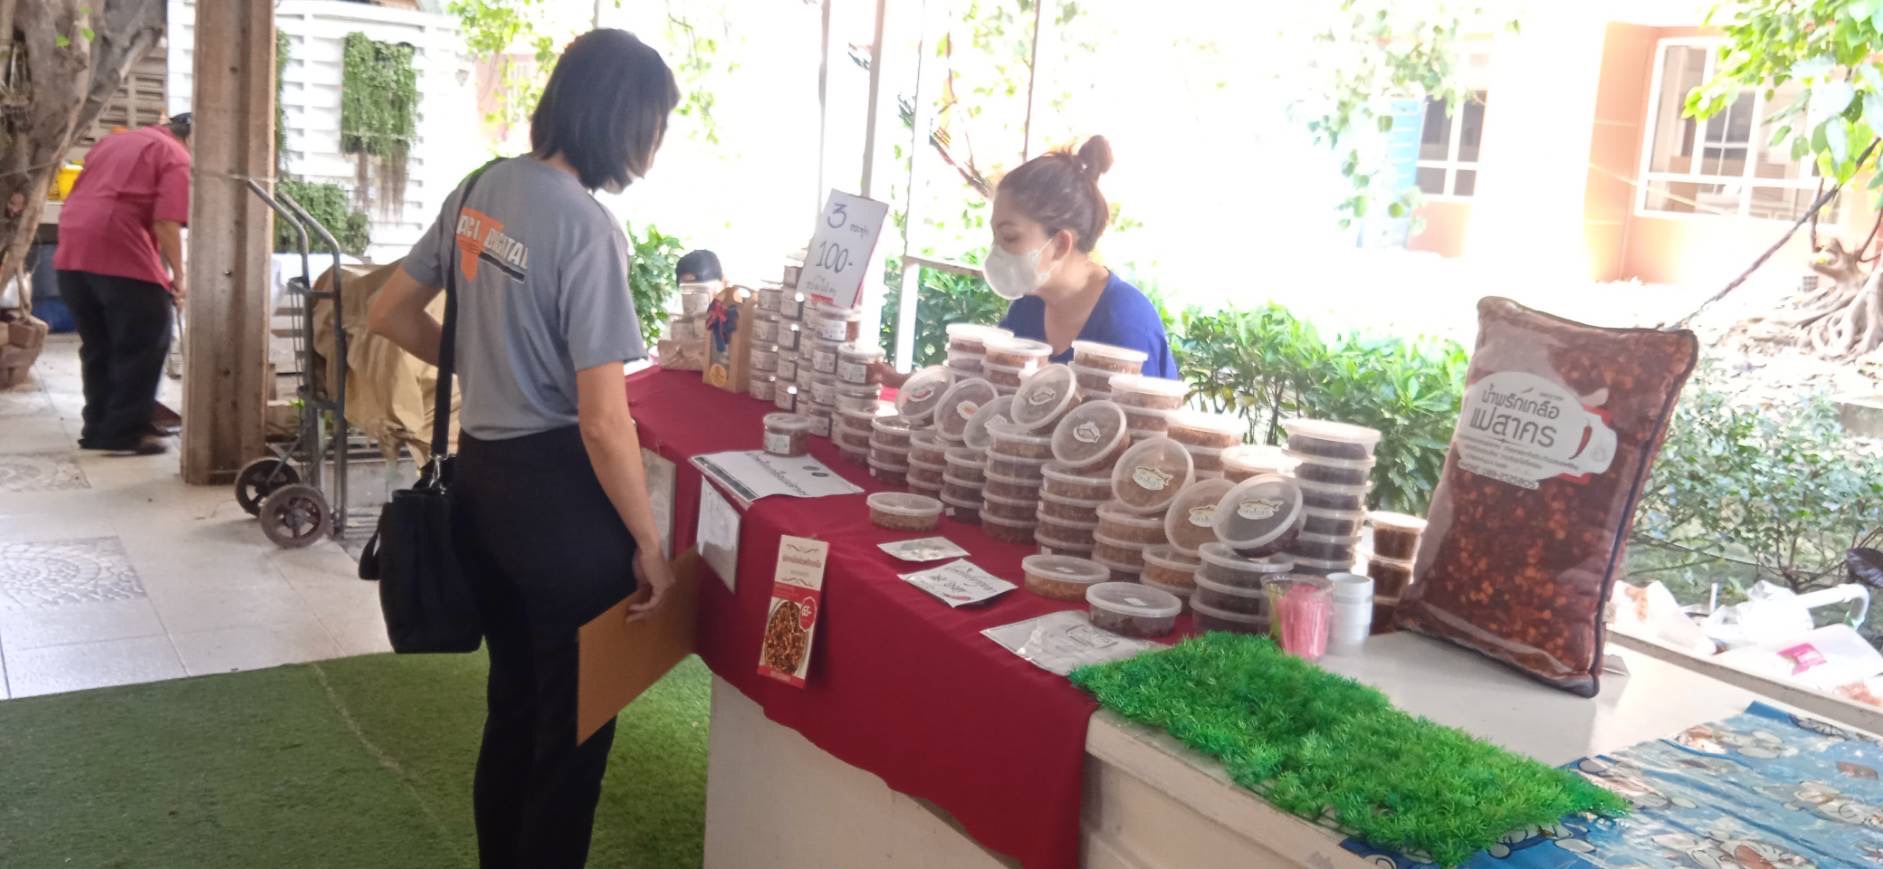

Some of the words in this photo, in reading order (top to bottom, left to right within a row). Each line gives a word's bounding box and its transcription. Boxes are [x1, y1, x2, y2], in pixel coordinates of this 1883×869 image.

[827, 203, 847, 229] 3
[483, 228, 528, 269] DIGITAL
[1481, 384, 1560, 419] น้ำพริกเกลือ
[1470, 406, 1557, 447] แม่สาคร
